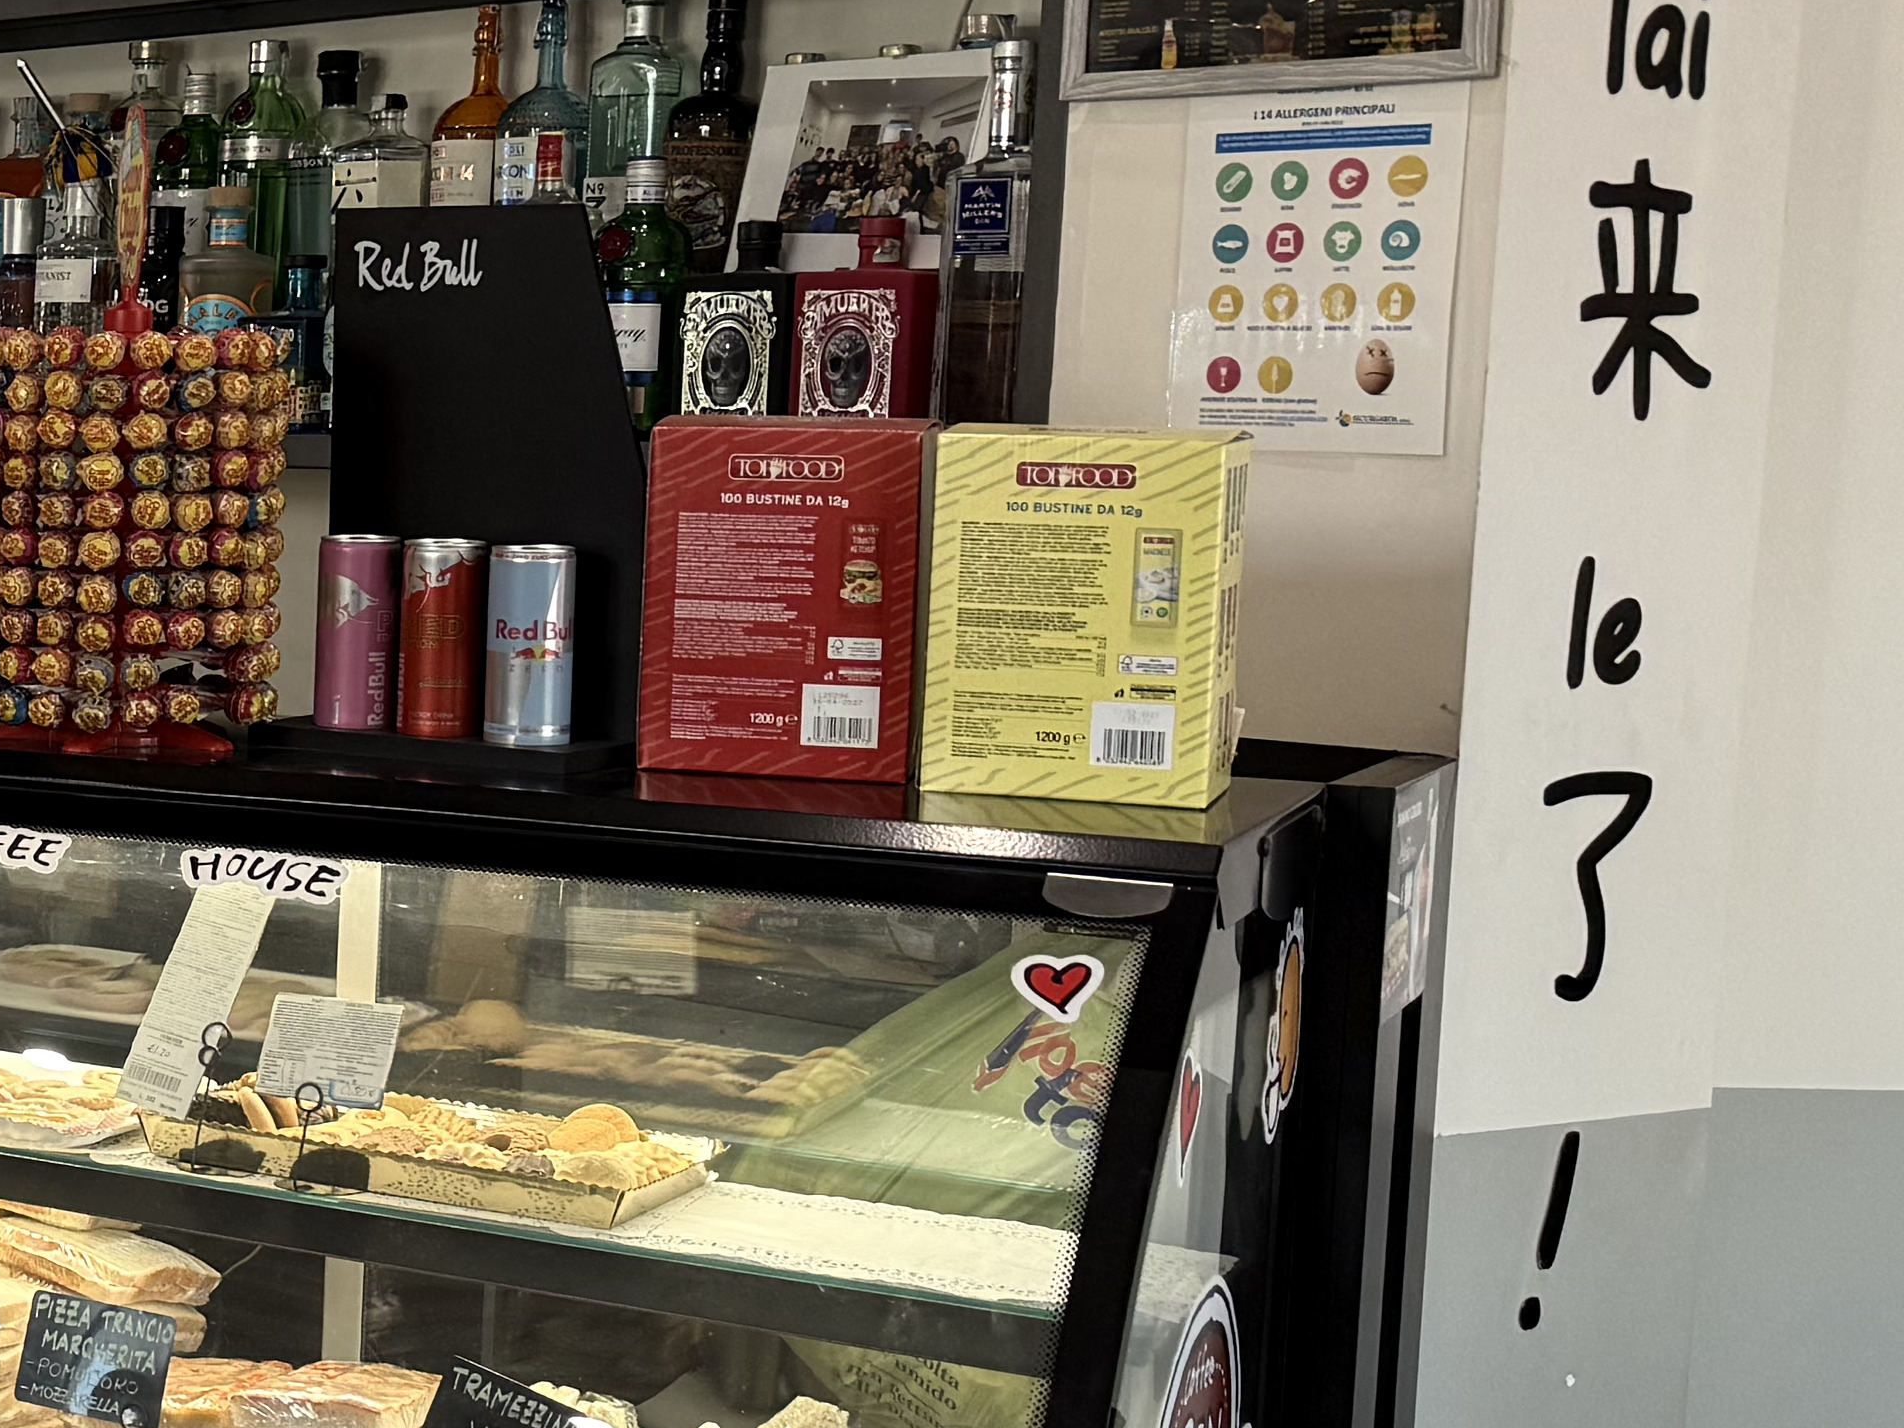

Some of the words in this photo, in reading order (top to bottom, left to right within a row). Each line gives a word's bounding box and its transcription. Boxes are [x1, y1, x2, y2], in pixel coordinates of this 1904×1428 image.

[1275, 107, 1332, 119] ALLERGENI
[1335, 104, 1395, 117] PRINCIPALI
[354, 238, 413, 292] Red
[420, 238, 483, 291] Bull
[1580, 158, 1711, 421] 来
[720, 492, 742, 505] 100
[746, 493, 802, 506] BUSTINE
[805, 495, 824, 506] DA
[828, 495, 849, 508] 12g
[1005, 501, 1029, 513] 100
[1033, 502, 1093, 516] BUSTINE
[1097, 504, 1115, 516] DA
[1120, 505, 1143, 518] 12g
[495, 618, 538, 641] Red
[1565, 554, 1643, 689] le
[749, 712, 773, 724] 1200
[777, 715, 783, 727] g
[1035, 730, 1059, 743] 1200
[1063, 734, 1070, 746] g
[190, 852, 342, 897] HOUSE
[1543, 769, 1653, 1002] 了
[1518, 1130, 1582, 1331] !
[37, 1294, 90, 1327] PIZZA
[101, 1310, 175, 1344] TRANCIO
[42, 1329, 157, 1374] MARGHERITA
